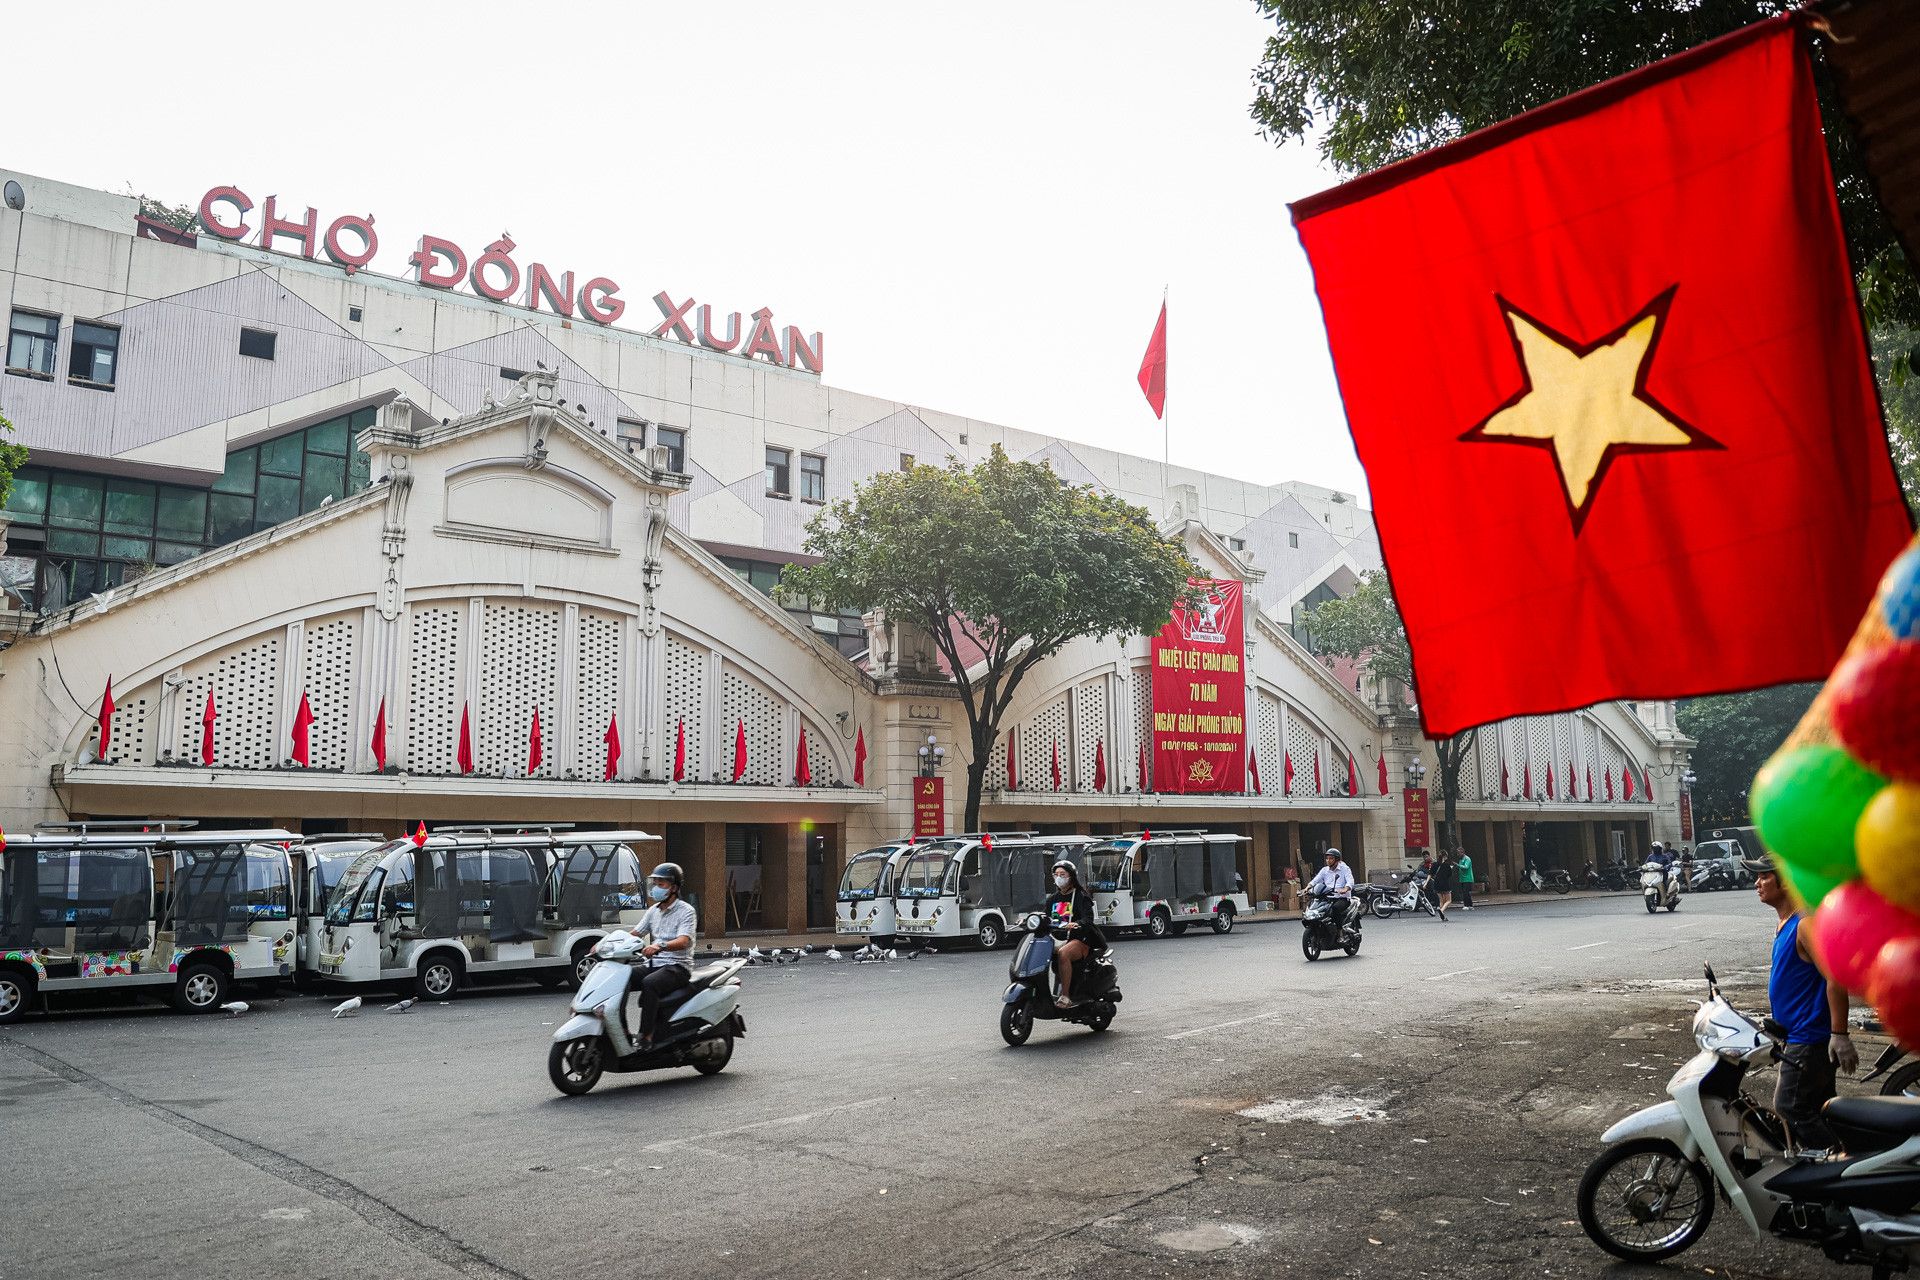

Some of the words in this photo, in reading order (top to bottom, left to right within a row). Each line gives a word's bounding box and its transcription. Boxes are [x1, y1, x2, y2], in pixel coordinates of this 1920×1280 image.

[197, 185, 378, 276] CHỢ
[408, 234, 625, 323] ĐỒNG
[652, 290, 823, 373] XUÂN
[1159, 646, 1182, 672] NHIỆT
[1184, 647, 1200, 673] LIỆT
[1202, 649, 1220, 671] CHÀO
[1190, 683, 1199, 701] 70
[1201, 680, 1217, 702] NĂM
[1154, 709, 1176, 732] NGÀY
[1178, 708, 1195, 733] GIẢI
[1196, 711, 1220, 734] PHÓNG
